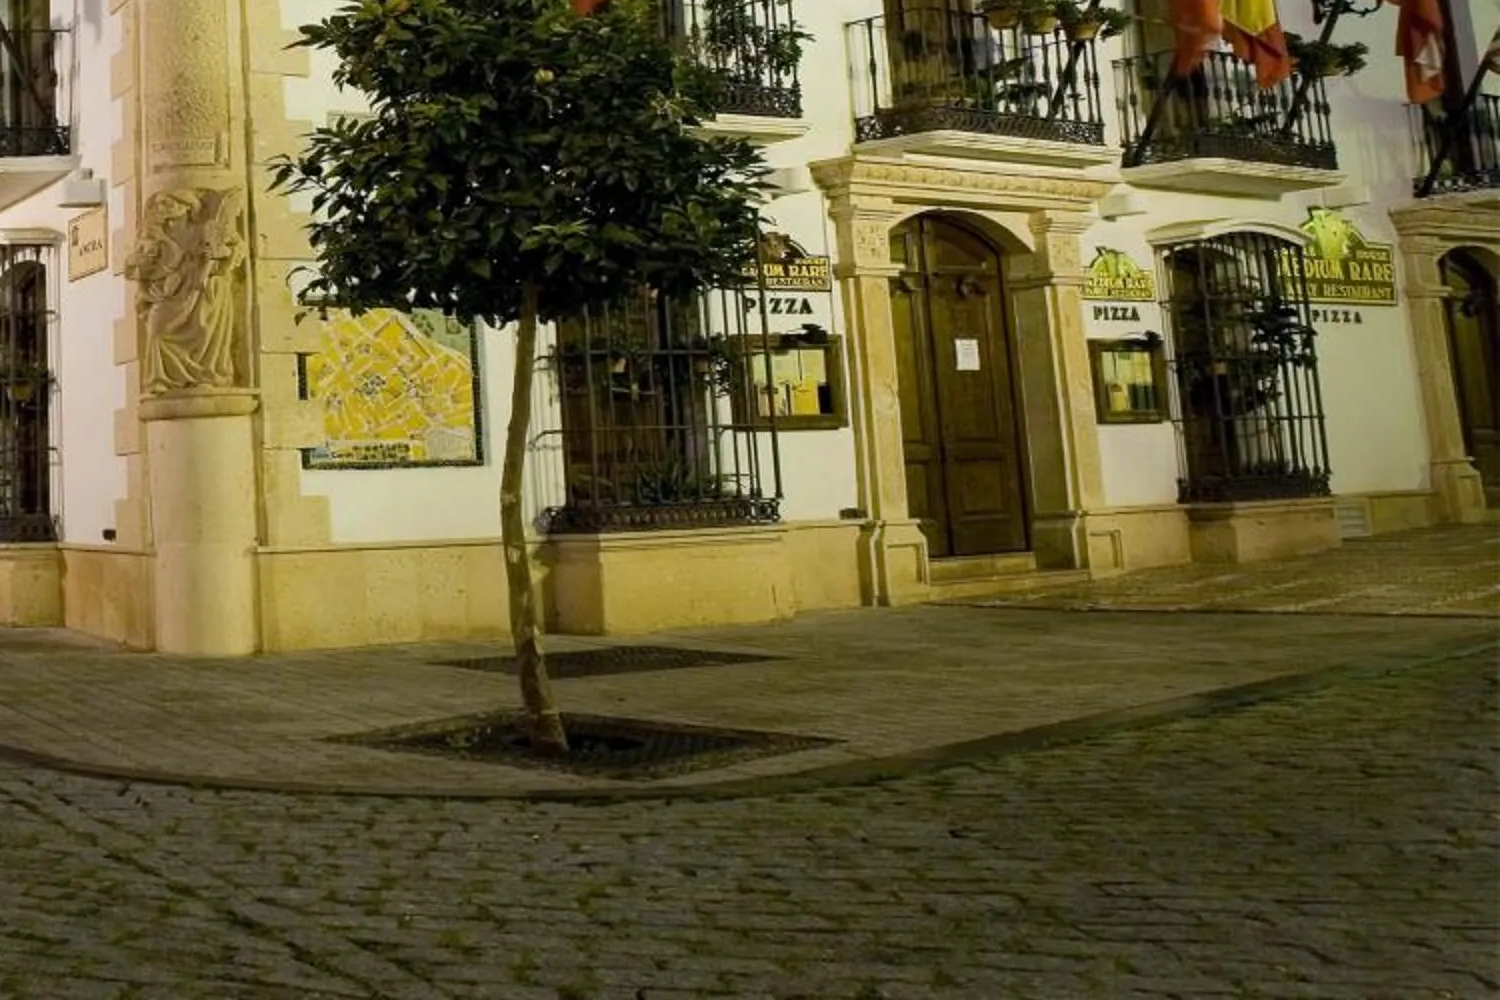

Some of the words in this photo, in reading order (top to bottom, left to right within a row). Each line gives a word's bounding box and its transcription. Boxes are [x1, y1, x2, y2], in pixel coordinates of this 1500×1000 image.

[789, 265, 830, 278] RARE
[1348, 261, 1395, 281] RARE
[1092, 305, 1141, 321] PIZZA
[1311, 309, 1364, 324] PIZZA
